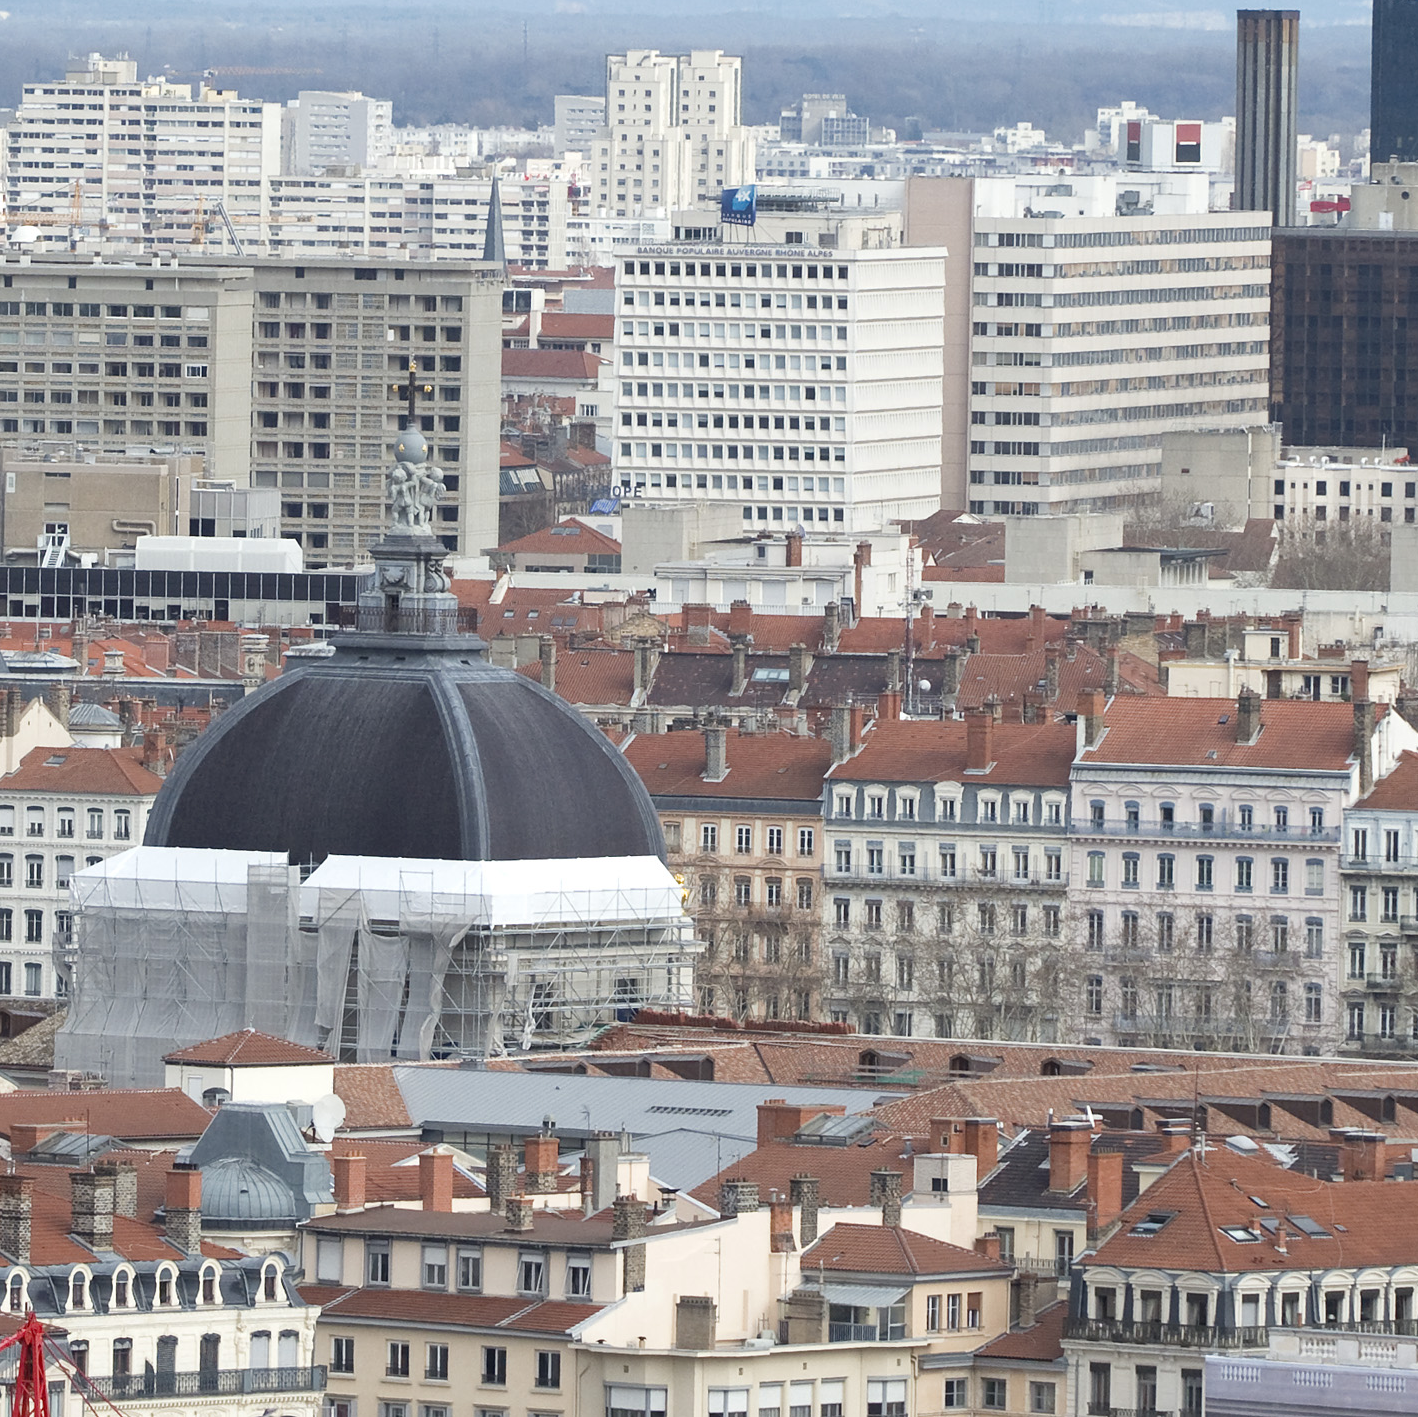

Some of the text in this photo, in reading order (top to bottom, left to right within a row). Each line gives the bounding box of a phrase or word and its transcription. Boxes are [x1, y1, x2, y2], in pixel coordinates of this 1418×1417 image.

[637, 246, 673, 255] BANQUE
[676, 247, 724, 255] POPULAIRE
[726, 248, 772, 256] AUVERGNE
